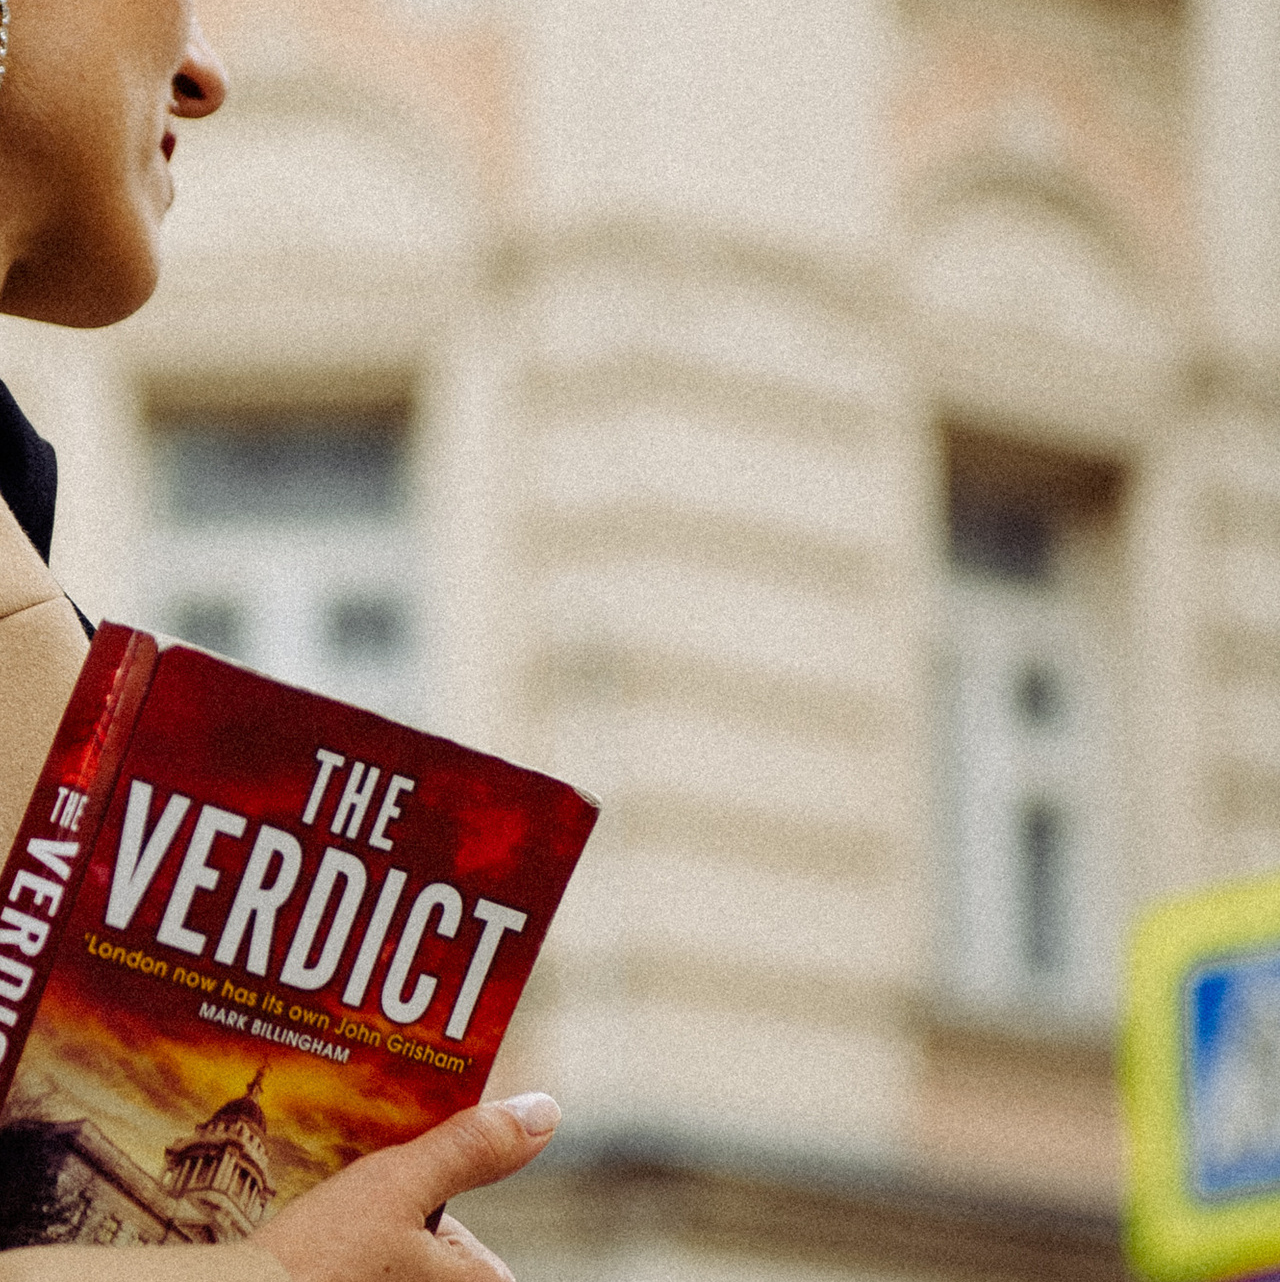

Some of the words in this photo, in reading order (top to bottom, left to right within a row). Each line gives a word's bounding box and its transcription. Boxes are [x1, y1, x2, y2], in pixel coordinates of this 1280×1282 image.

[50, 786, 88, 832] THE
[302, 748, 415, 851] THE
[105, 779, 528, 1040] VERDICT
[173, 966, 218, 994] now
[221, 979, 258, 1007] has
[262, 992, 285, 1016] its
[288, 1005, 330, 1031] own
[334, 1017, 381, 1048] John
[198, 1001, 249, 1031] MARK
[250, 1019, 351, 1064] BILLINGHAM
